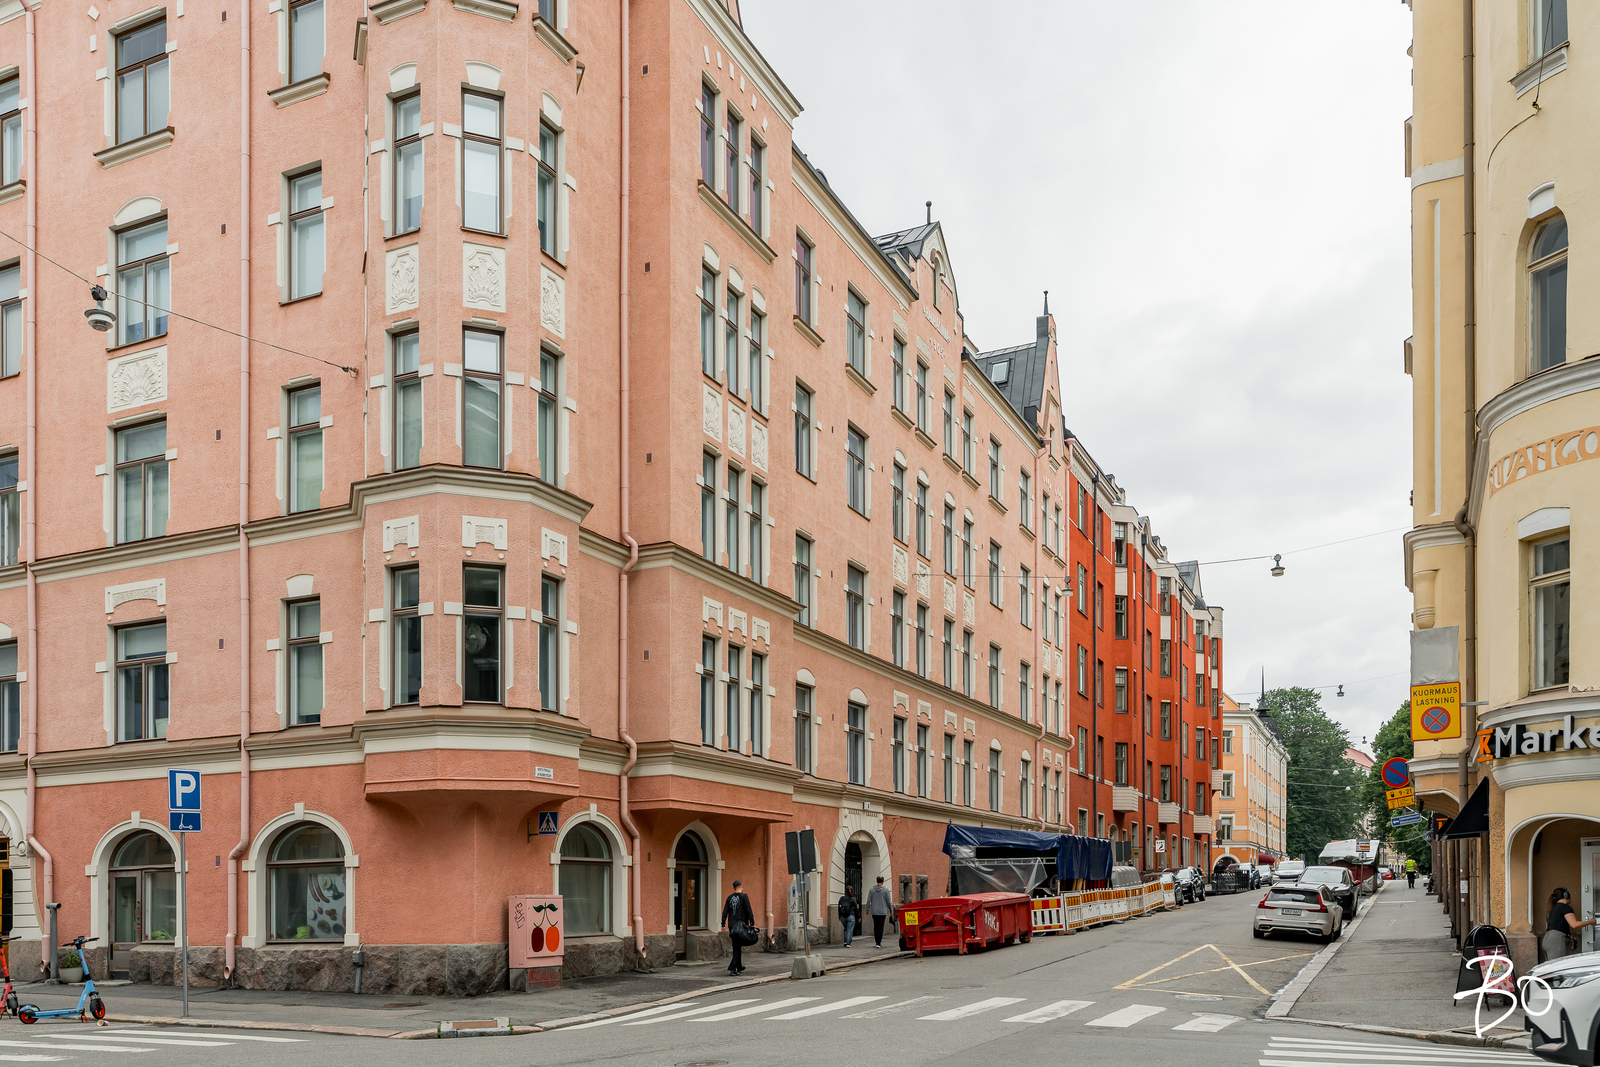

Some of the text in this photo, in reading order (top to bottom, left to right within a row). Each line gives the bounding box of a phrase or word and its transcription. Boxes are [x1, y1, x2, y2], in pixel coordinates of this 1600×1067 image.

[1413, 687, 1458, 697] KUORMAUS
[1416, 697, 1455, 706] LASTNING
[176, 773, 196, 807] P
